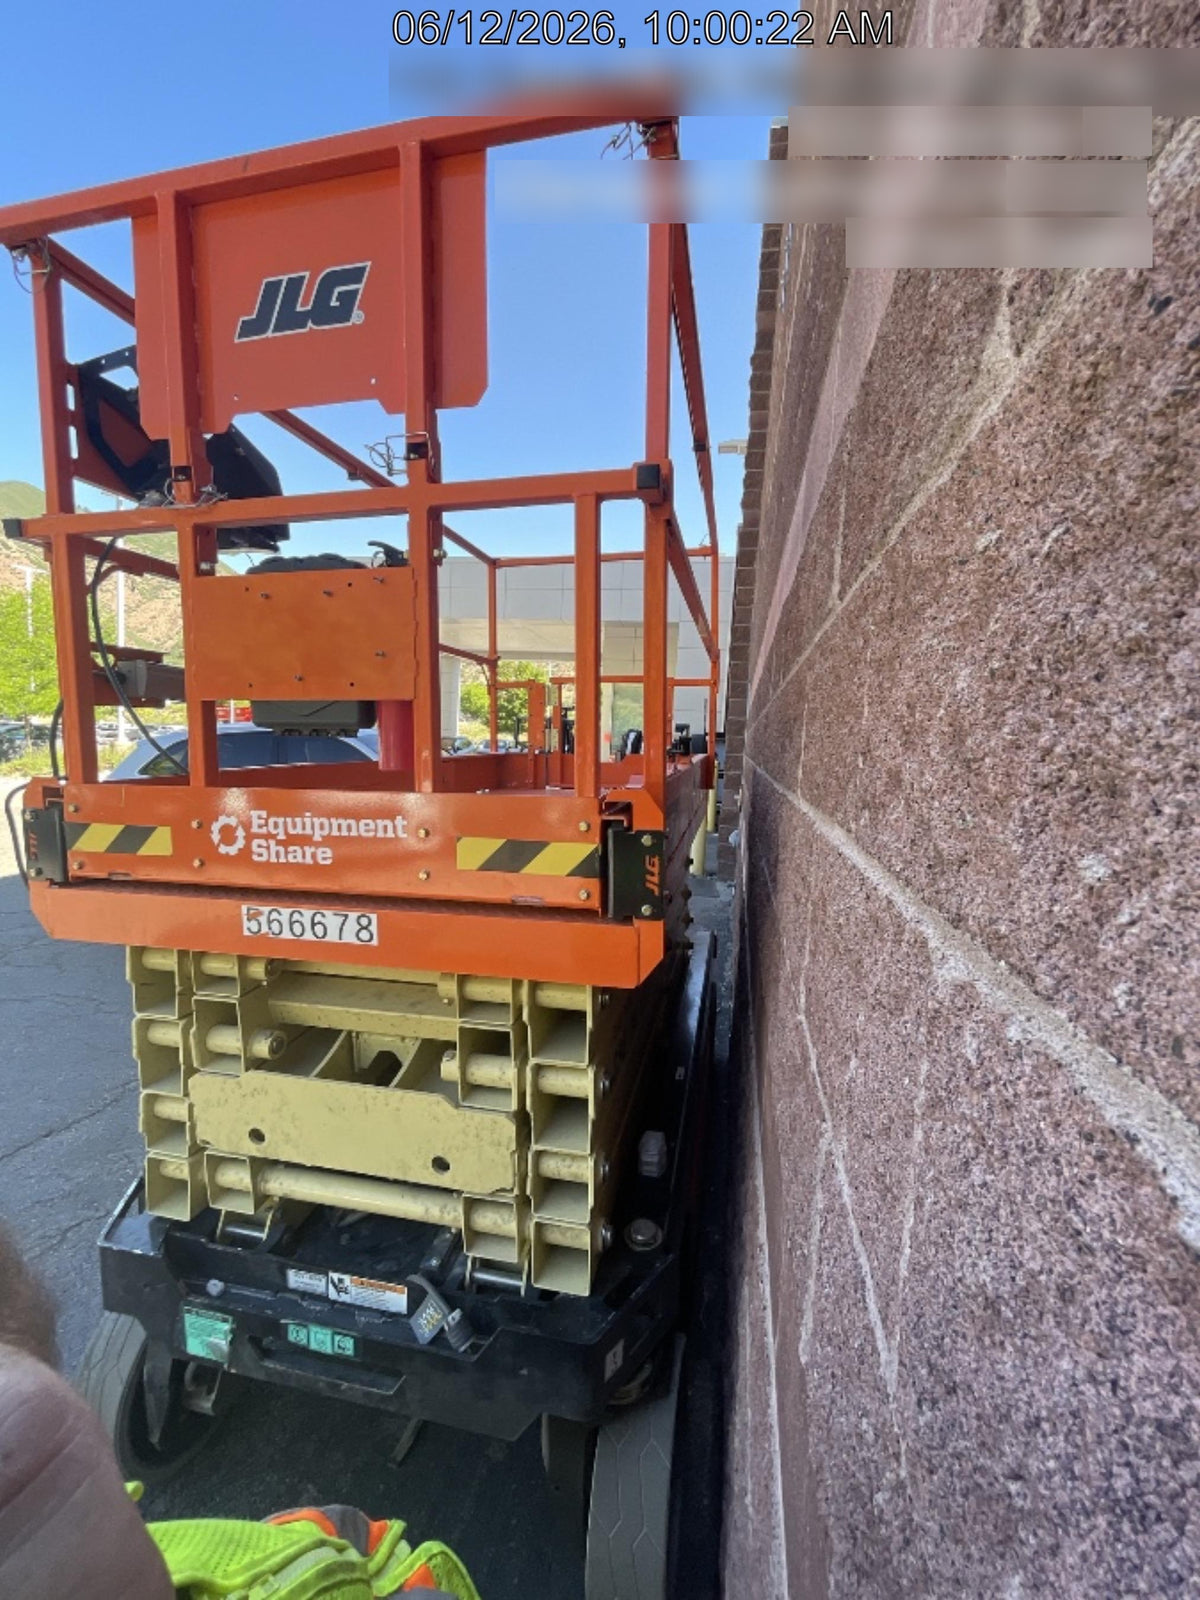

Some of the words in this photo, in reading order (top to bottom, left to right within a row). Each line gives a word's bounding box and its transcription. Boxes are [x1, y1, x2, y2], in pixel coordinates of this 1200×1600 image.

[234, 261, 372, 343] JLG
[250, 810, 408, 841] Equipment
[251, 838, 334, 865] Share
[645, 855, 660, 896] JLG
[246, 907, 374, 943] 566678
